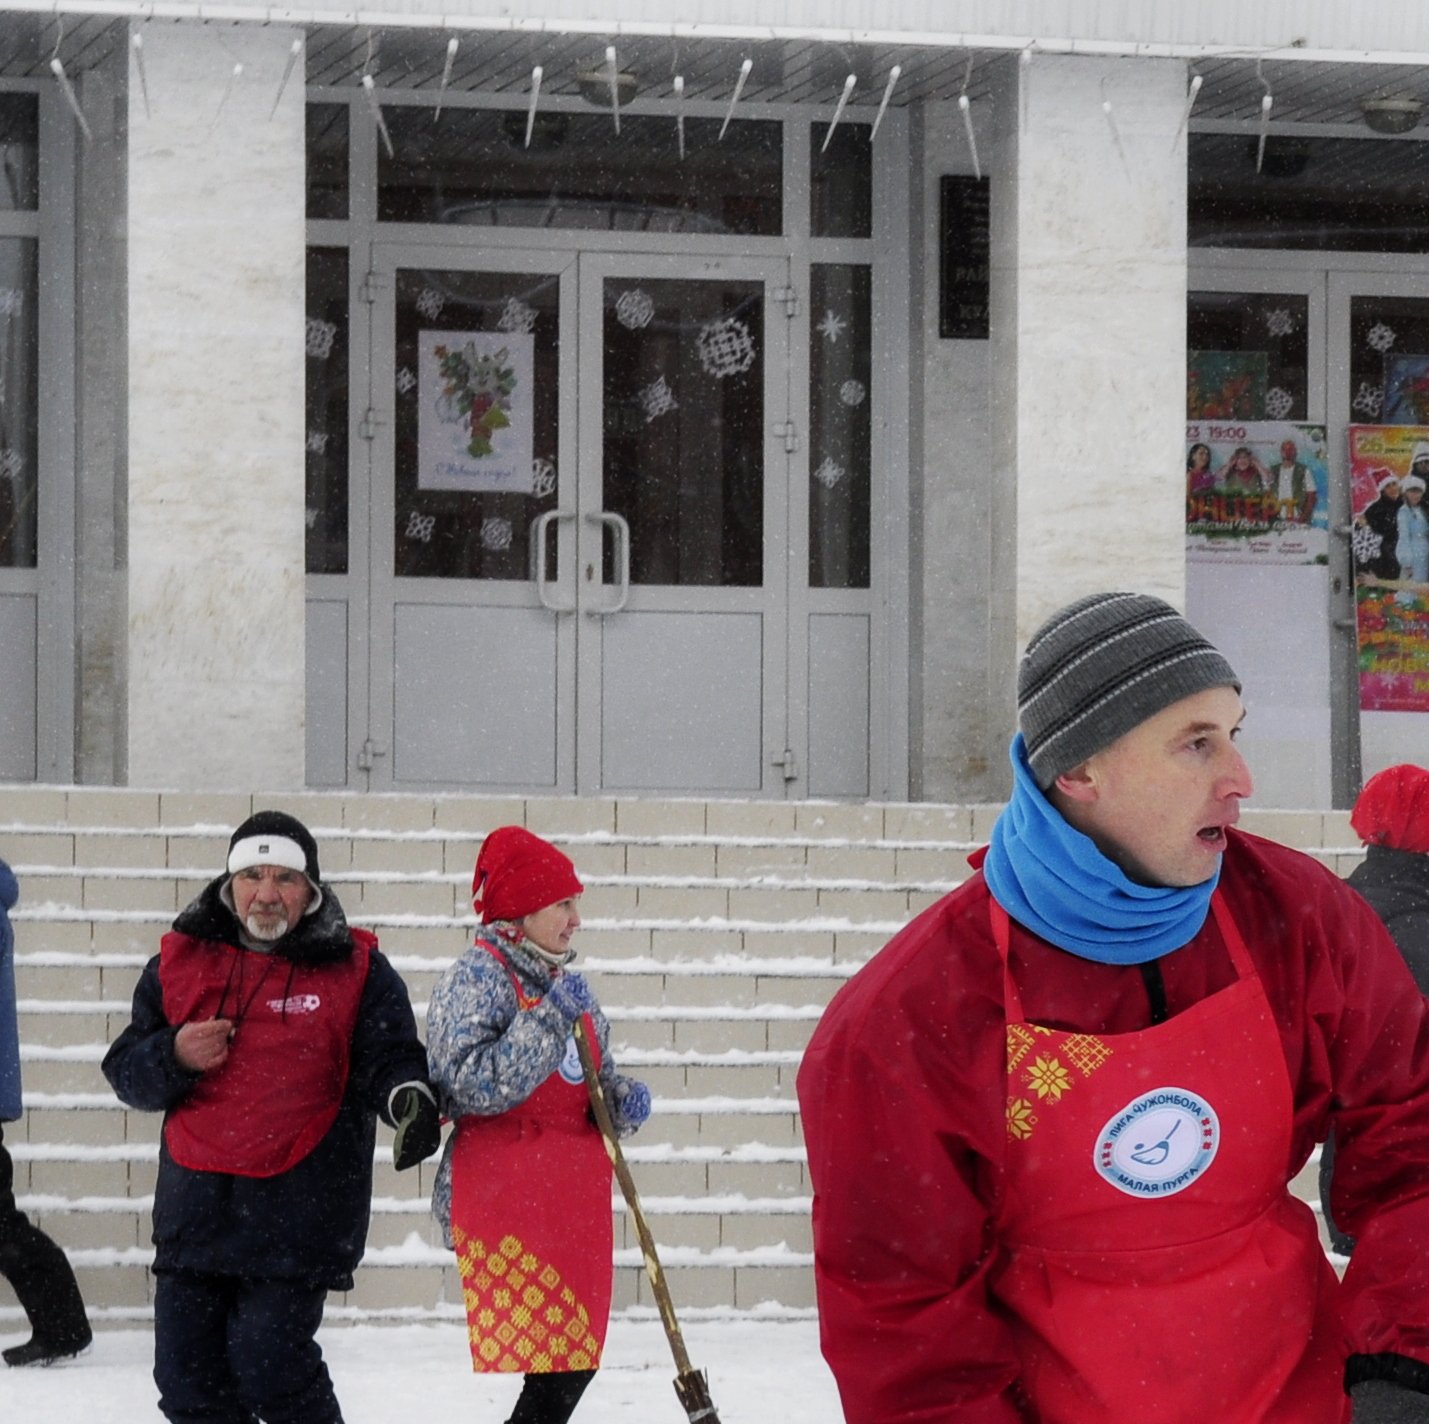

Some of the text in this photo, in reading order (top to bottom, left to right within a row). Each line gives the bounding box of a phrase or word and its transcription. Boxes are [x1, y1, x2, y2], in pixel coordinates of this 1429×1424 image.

[1208, 426, 1247, 438] 19:00
[1109, 1113, 1135, 1138] ЛИГА
[1117, 1167, 1199, 1192] МАЛАЯ ПУРГА
